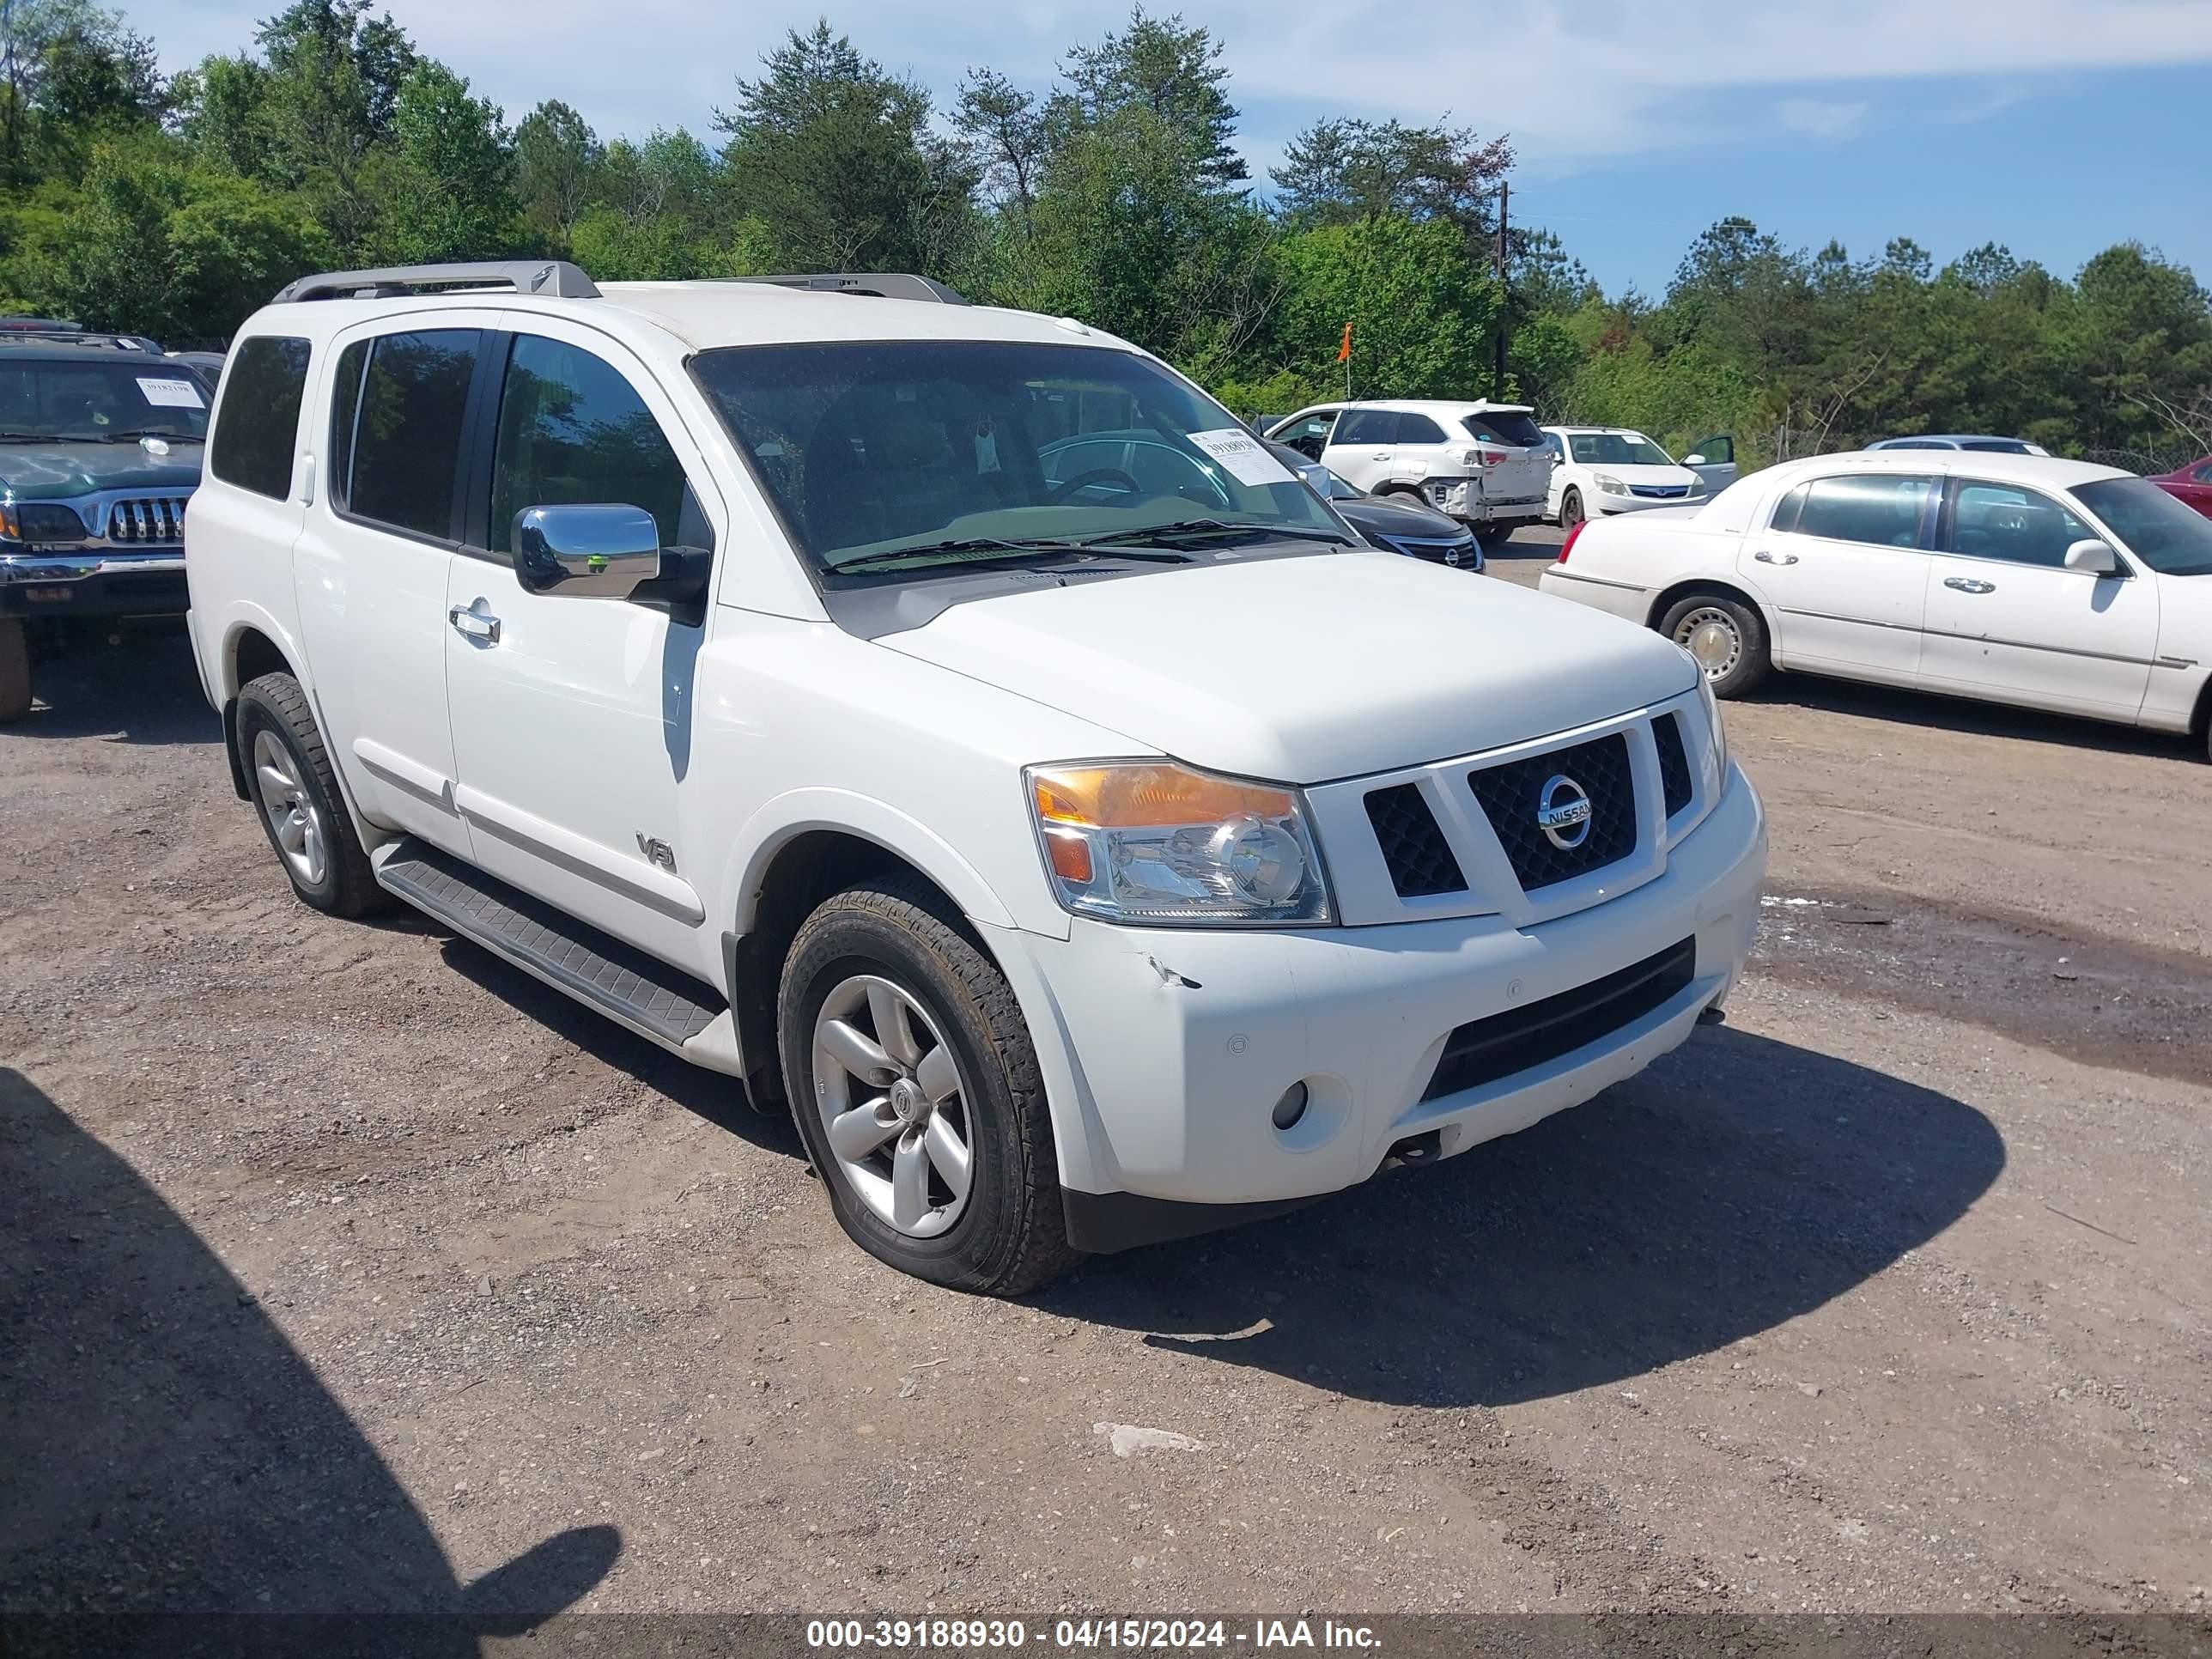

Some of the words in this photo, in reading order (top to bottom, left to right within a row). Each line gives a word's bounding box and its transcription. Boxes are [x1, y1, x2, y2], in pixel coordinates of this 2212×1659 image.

[1206, 439, 1257, 454] 39188930
[1548, 803, 1592, 824] NISSAN
[635, 830, 678, 875] V8
